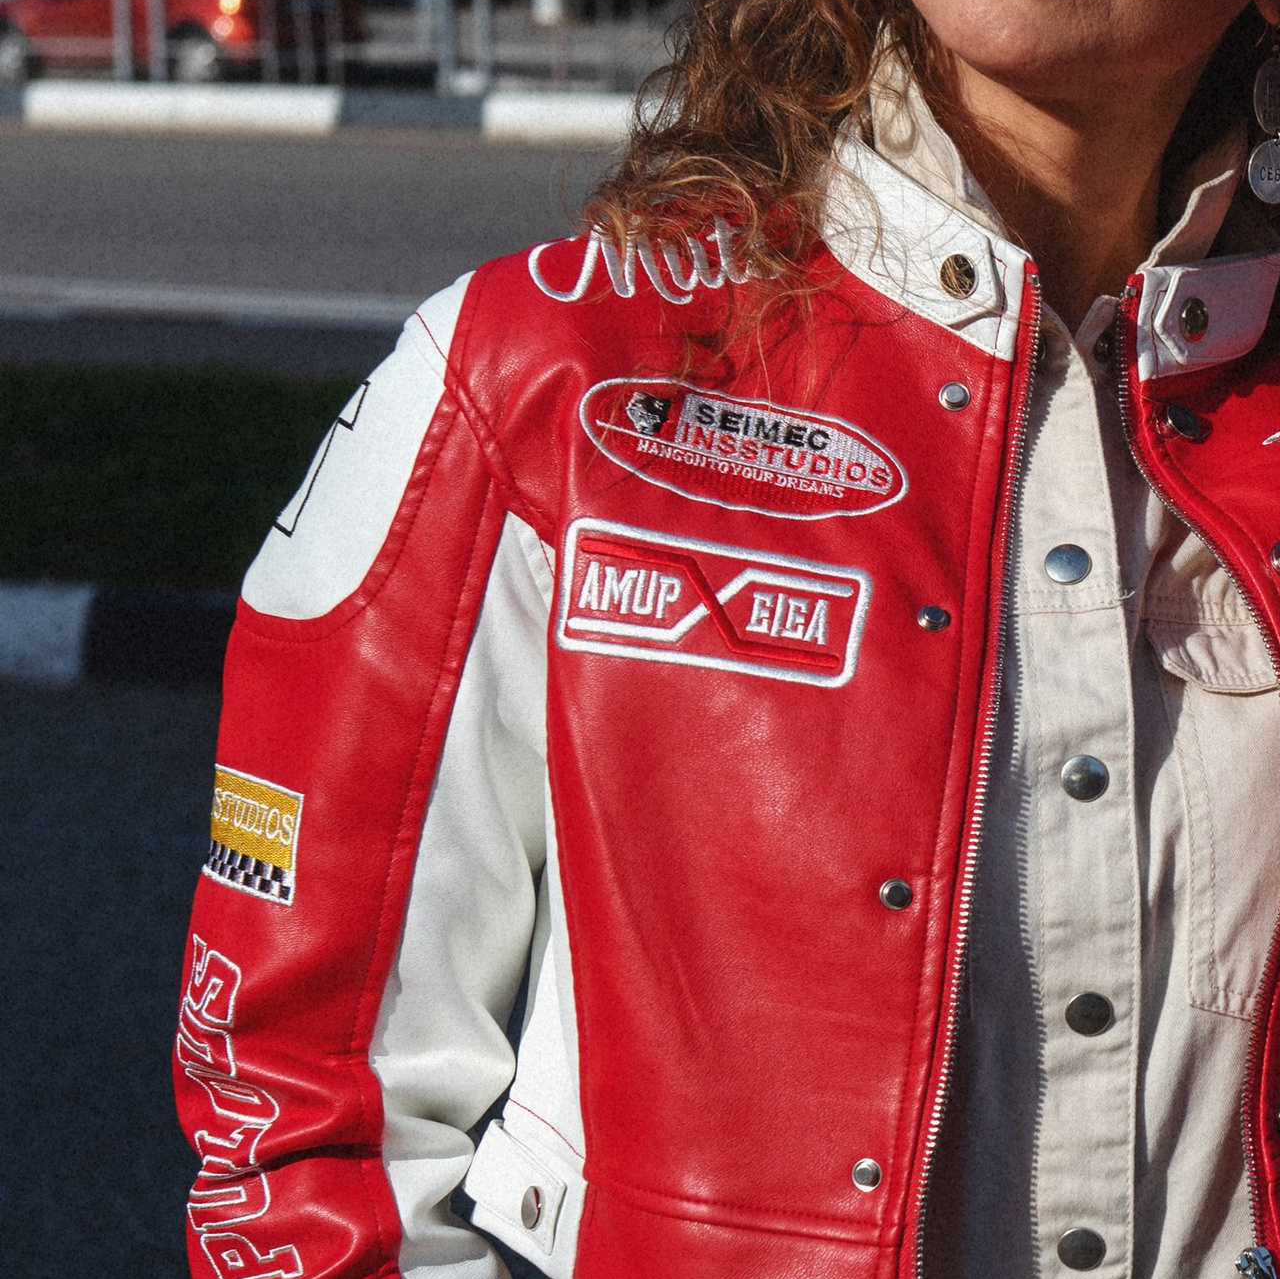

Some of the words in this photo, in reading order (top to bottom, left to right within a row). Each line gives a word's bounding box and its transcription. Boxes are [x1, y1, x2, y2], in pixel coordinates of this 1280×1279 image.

[527, 214, 777, 305] Mut
[682, 423, 891, 488] INSSTUDIOS
[696, 403, 830, 450] SEIMEC
[577, 561, 682, 619] AMUP
[211, 787, 294, 846] STUDIOS
